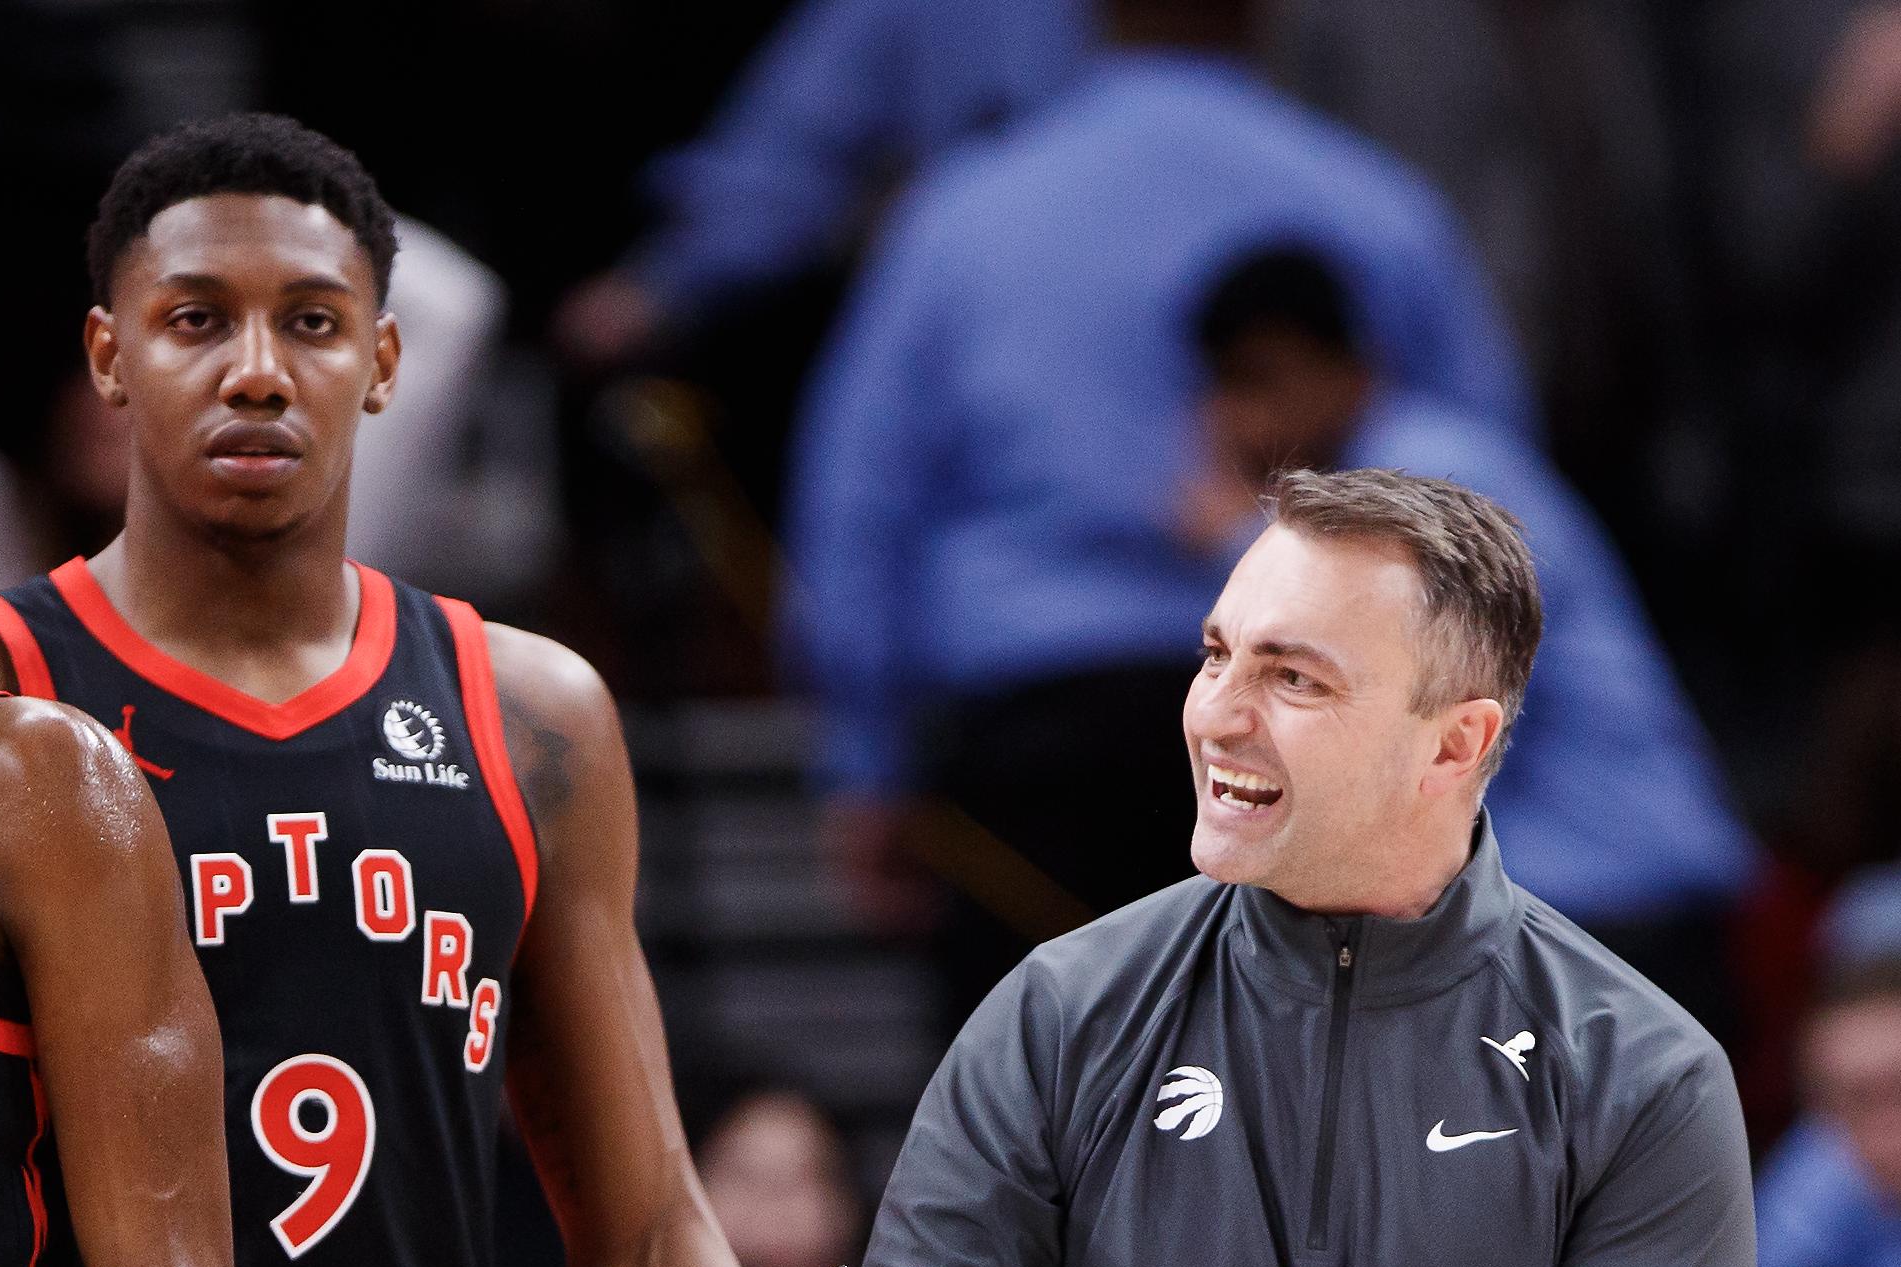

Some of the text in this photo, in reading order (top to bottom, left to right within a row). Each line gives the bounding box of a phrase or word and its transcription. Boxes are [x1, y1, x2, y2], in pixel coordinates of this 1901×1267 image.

[372, 757, 470, 790] Sun Life
[190, 811, 501, 1073] PTORS
[250, 1053, 376, 1260] 9
